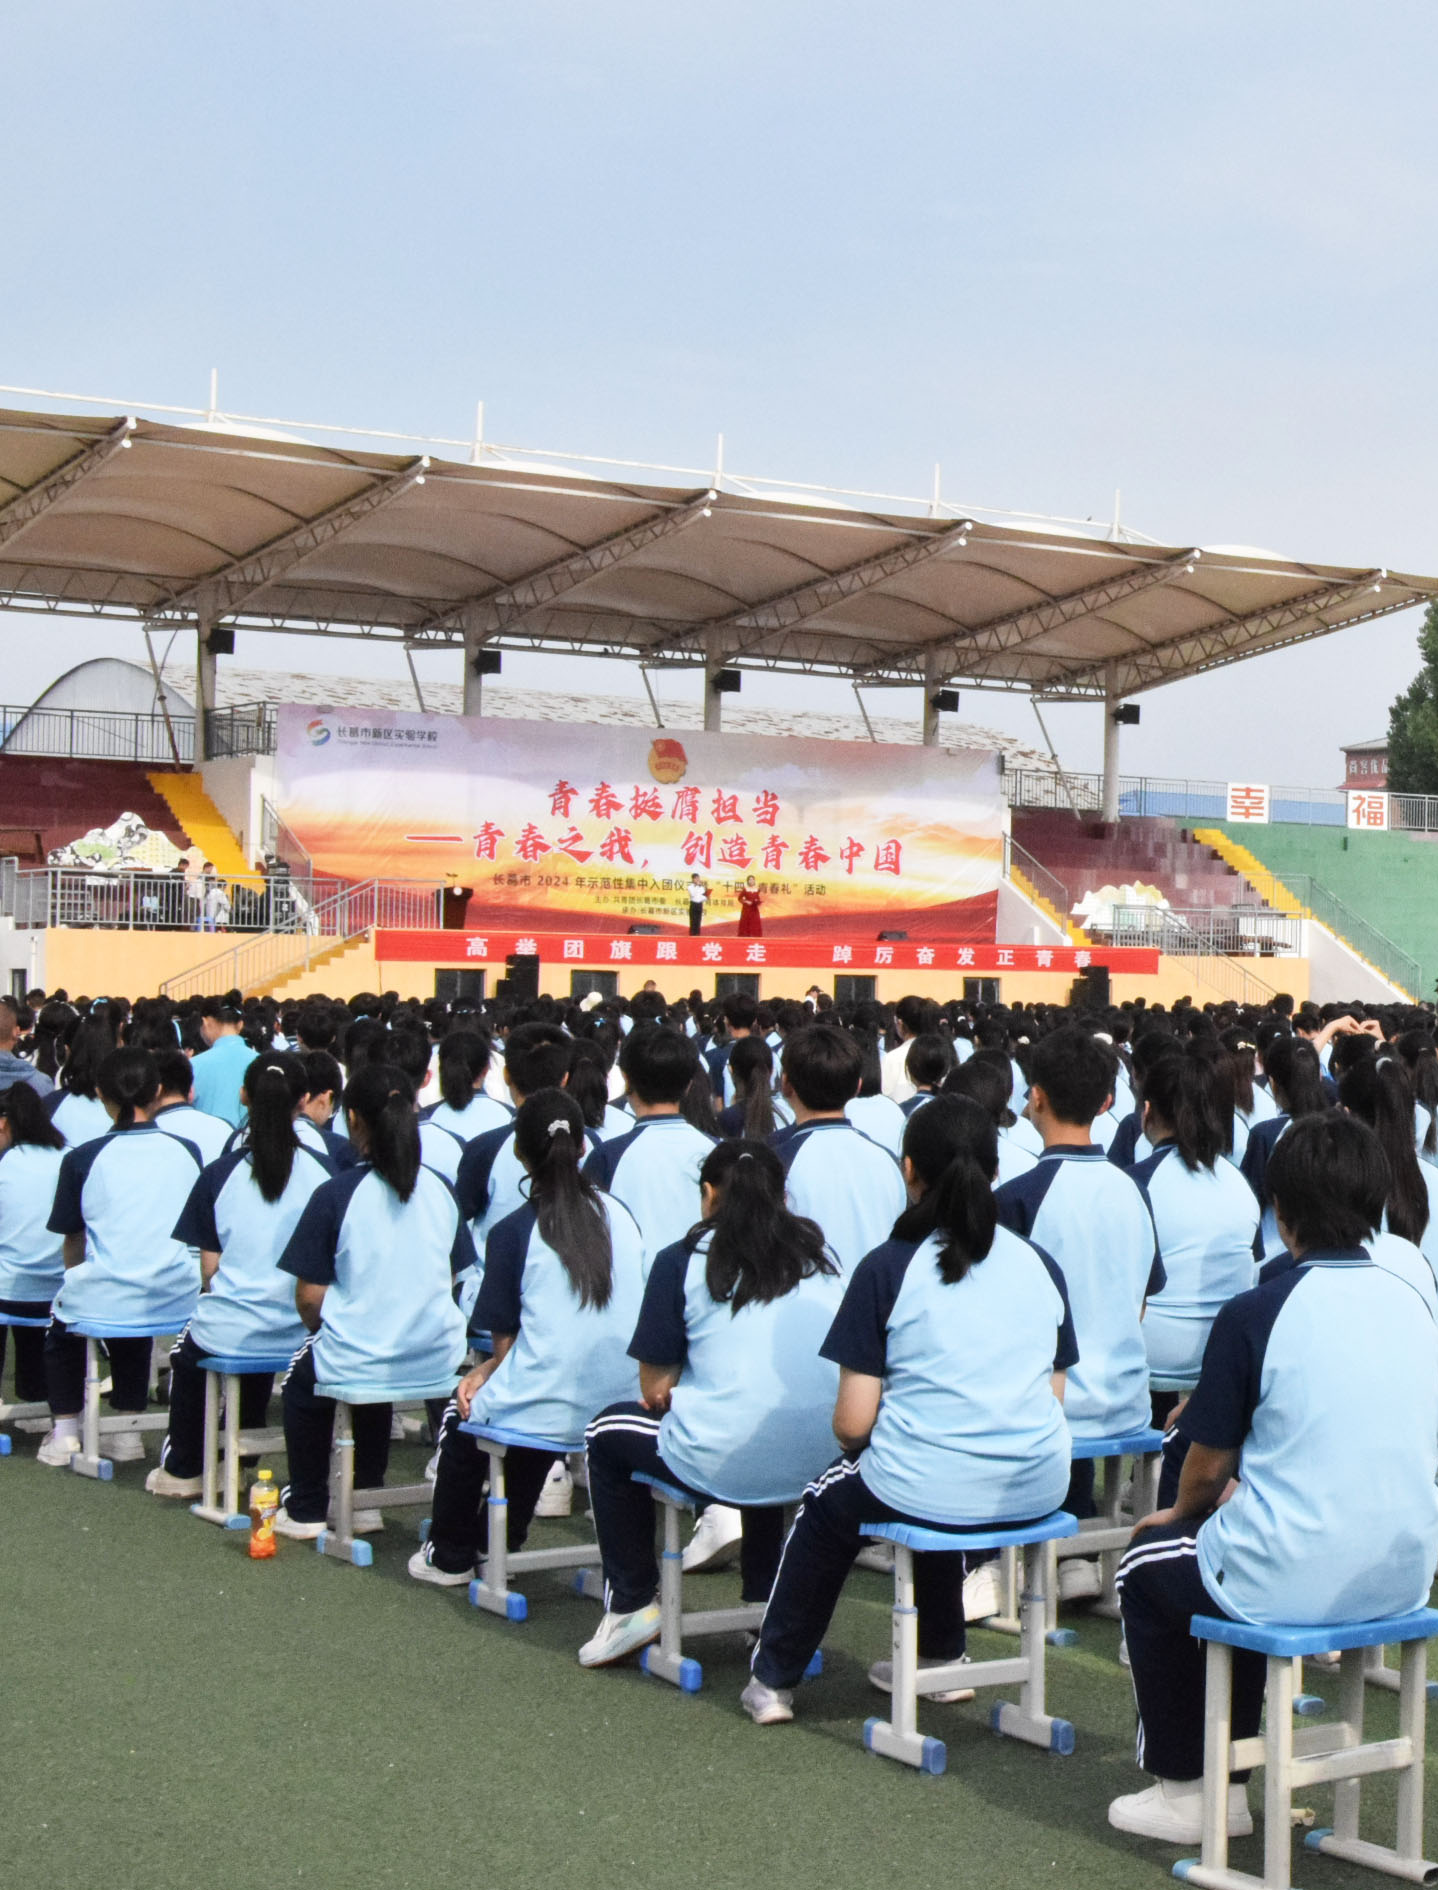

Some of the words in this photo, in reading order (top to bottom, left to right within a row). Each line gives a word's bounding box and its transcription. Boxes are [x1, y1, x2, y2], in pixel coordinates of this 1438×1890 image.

[337, 726, 438, 742] 长葛市新区实验学校
[548, 779, 781, 827] 青春挺膺担当
[537, 875, 569, 887] 2024
[466, 936, 767, 962] 高举团旗跟党走
[832, 944, 1092, 968] 踔厉奋发正青春
